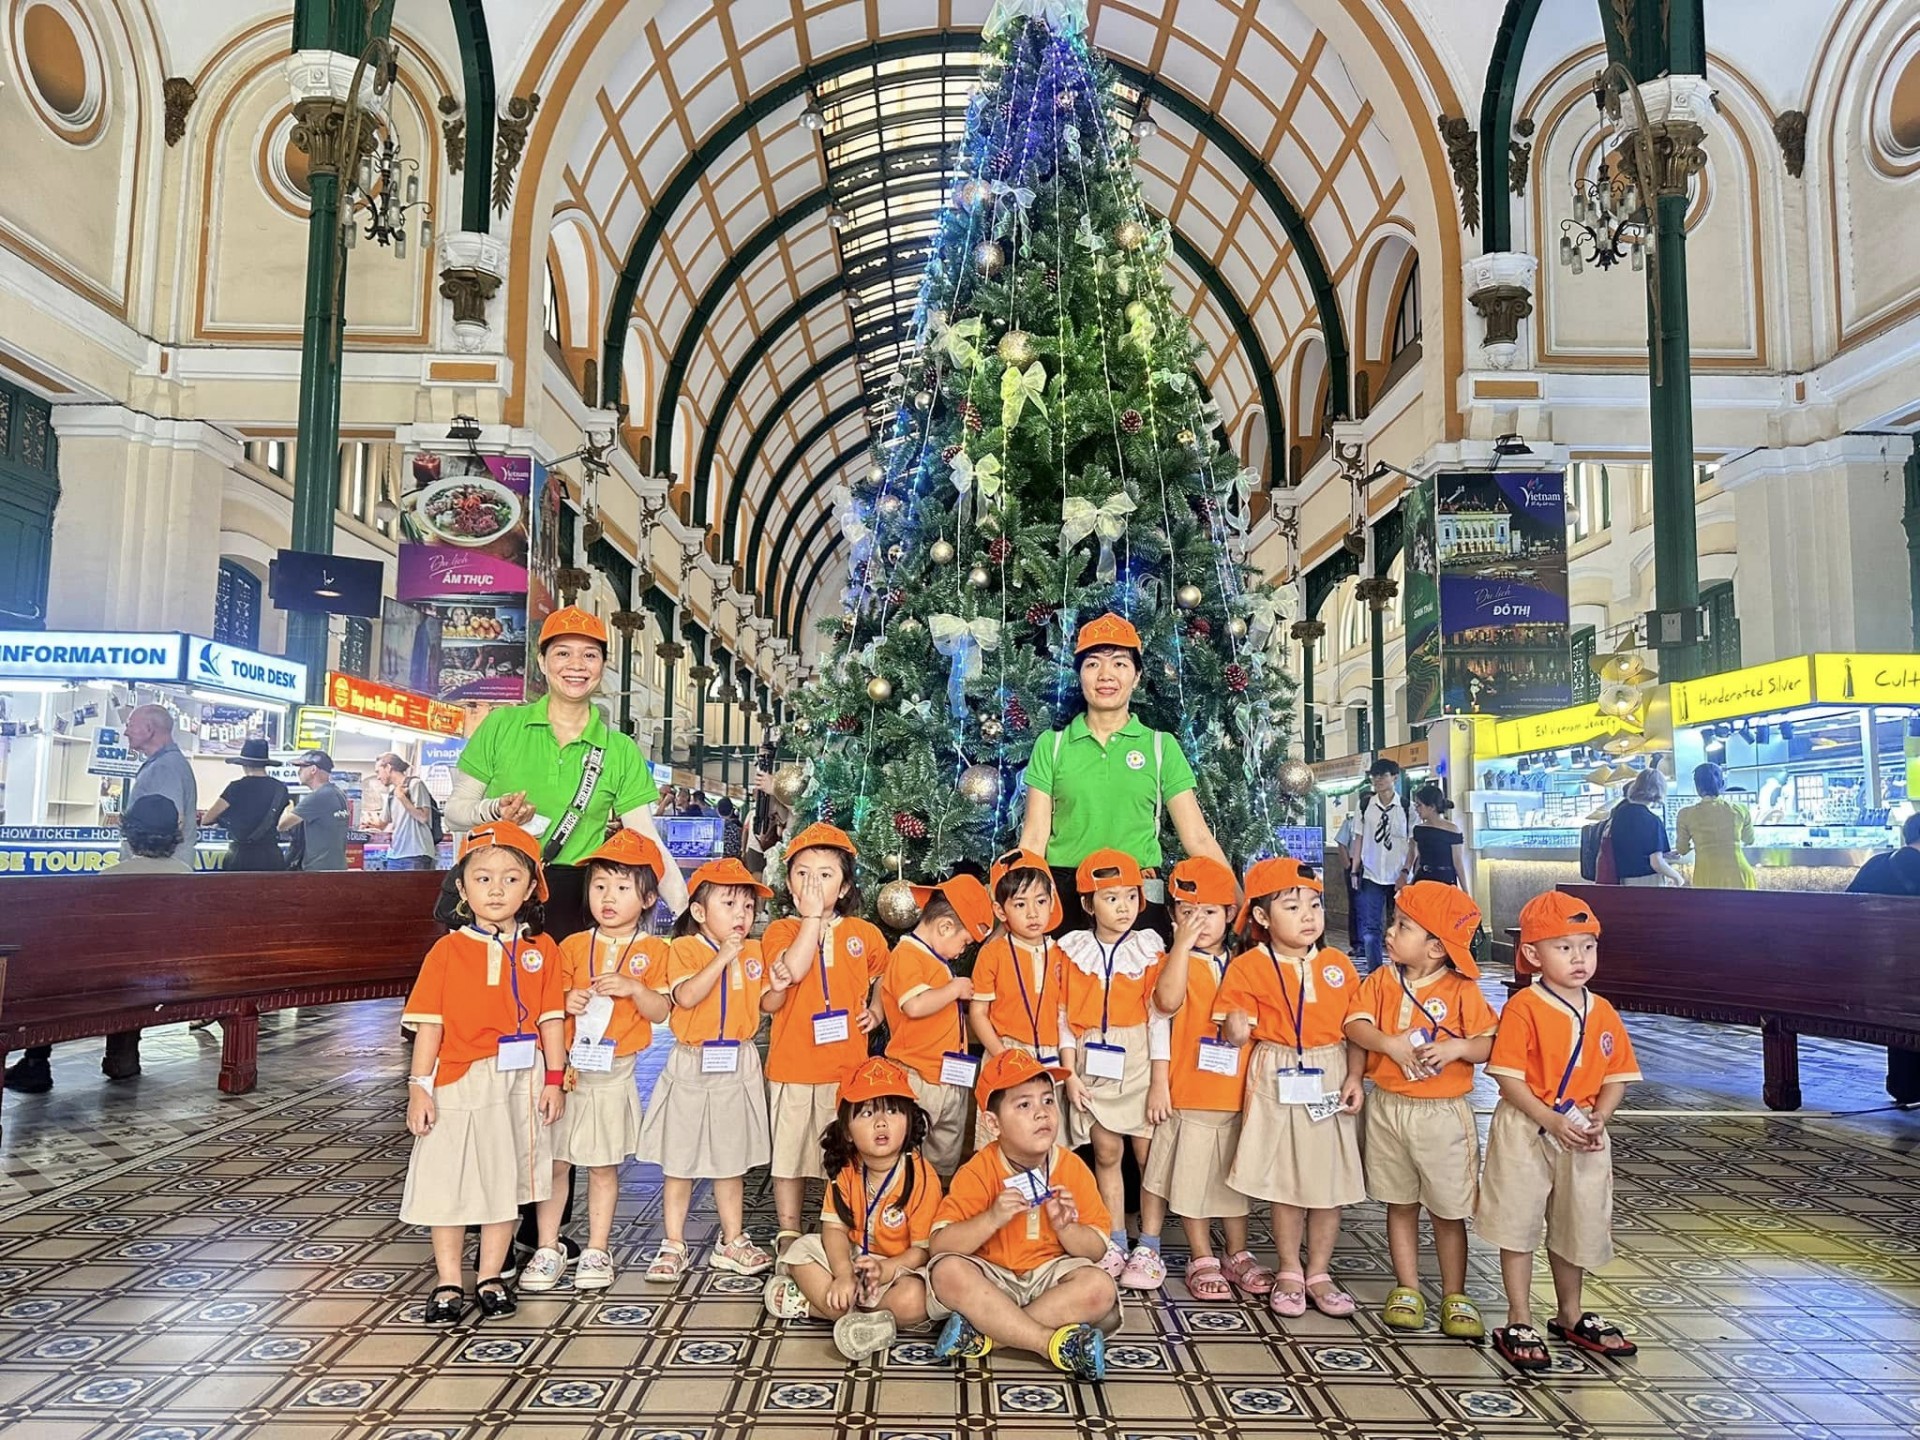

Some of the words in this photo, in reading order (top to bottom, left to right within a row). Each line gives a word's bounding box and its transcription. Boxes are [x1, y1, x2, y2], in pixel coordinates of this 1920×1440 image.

[1519, 486, 1561, 507] Vietnam
[463, 574, 495, 587] THỰC
[1493, 603, 1511, 616] ĐÔ
[1512, 605, 1531, 618] THỊ
[0, 645, 166, 664] NFORMATION
[231, 660, 265, 682] TOUR
[267, 668, 297, 689] DESK
[35, 828, 80, 840] TICKET
[29, 850, 121, 872] TOURS
